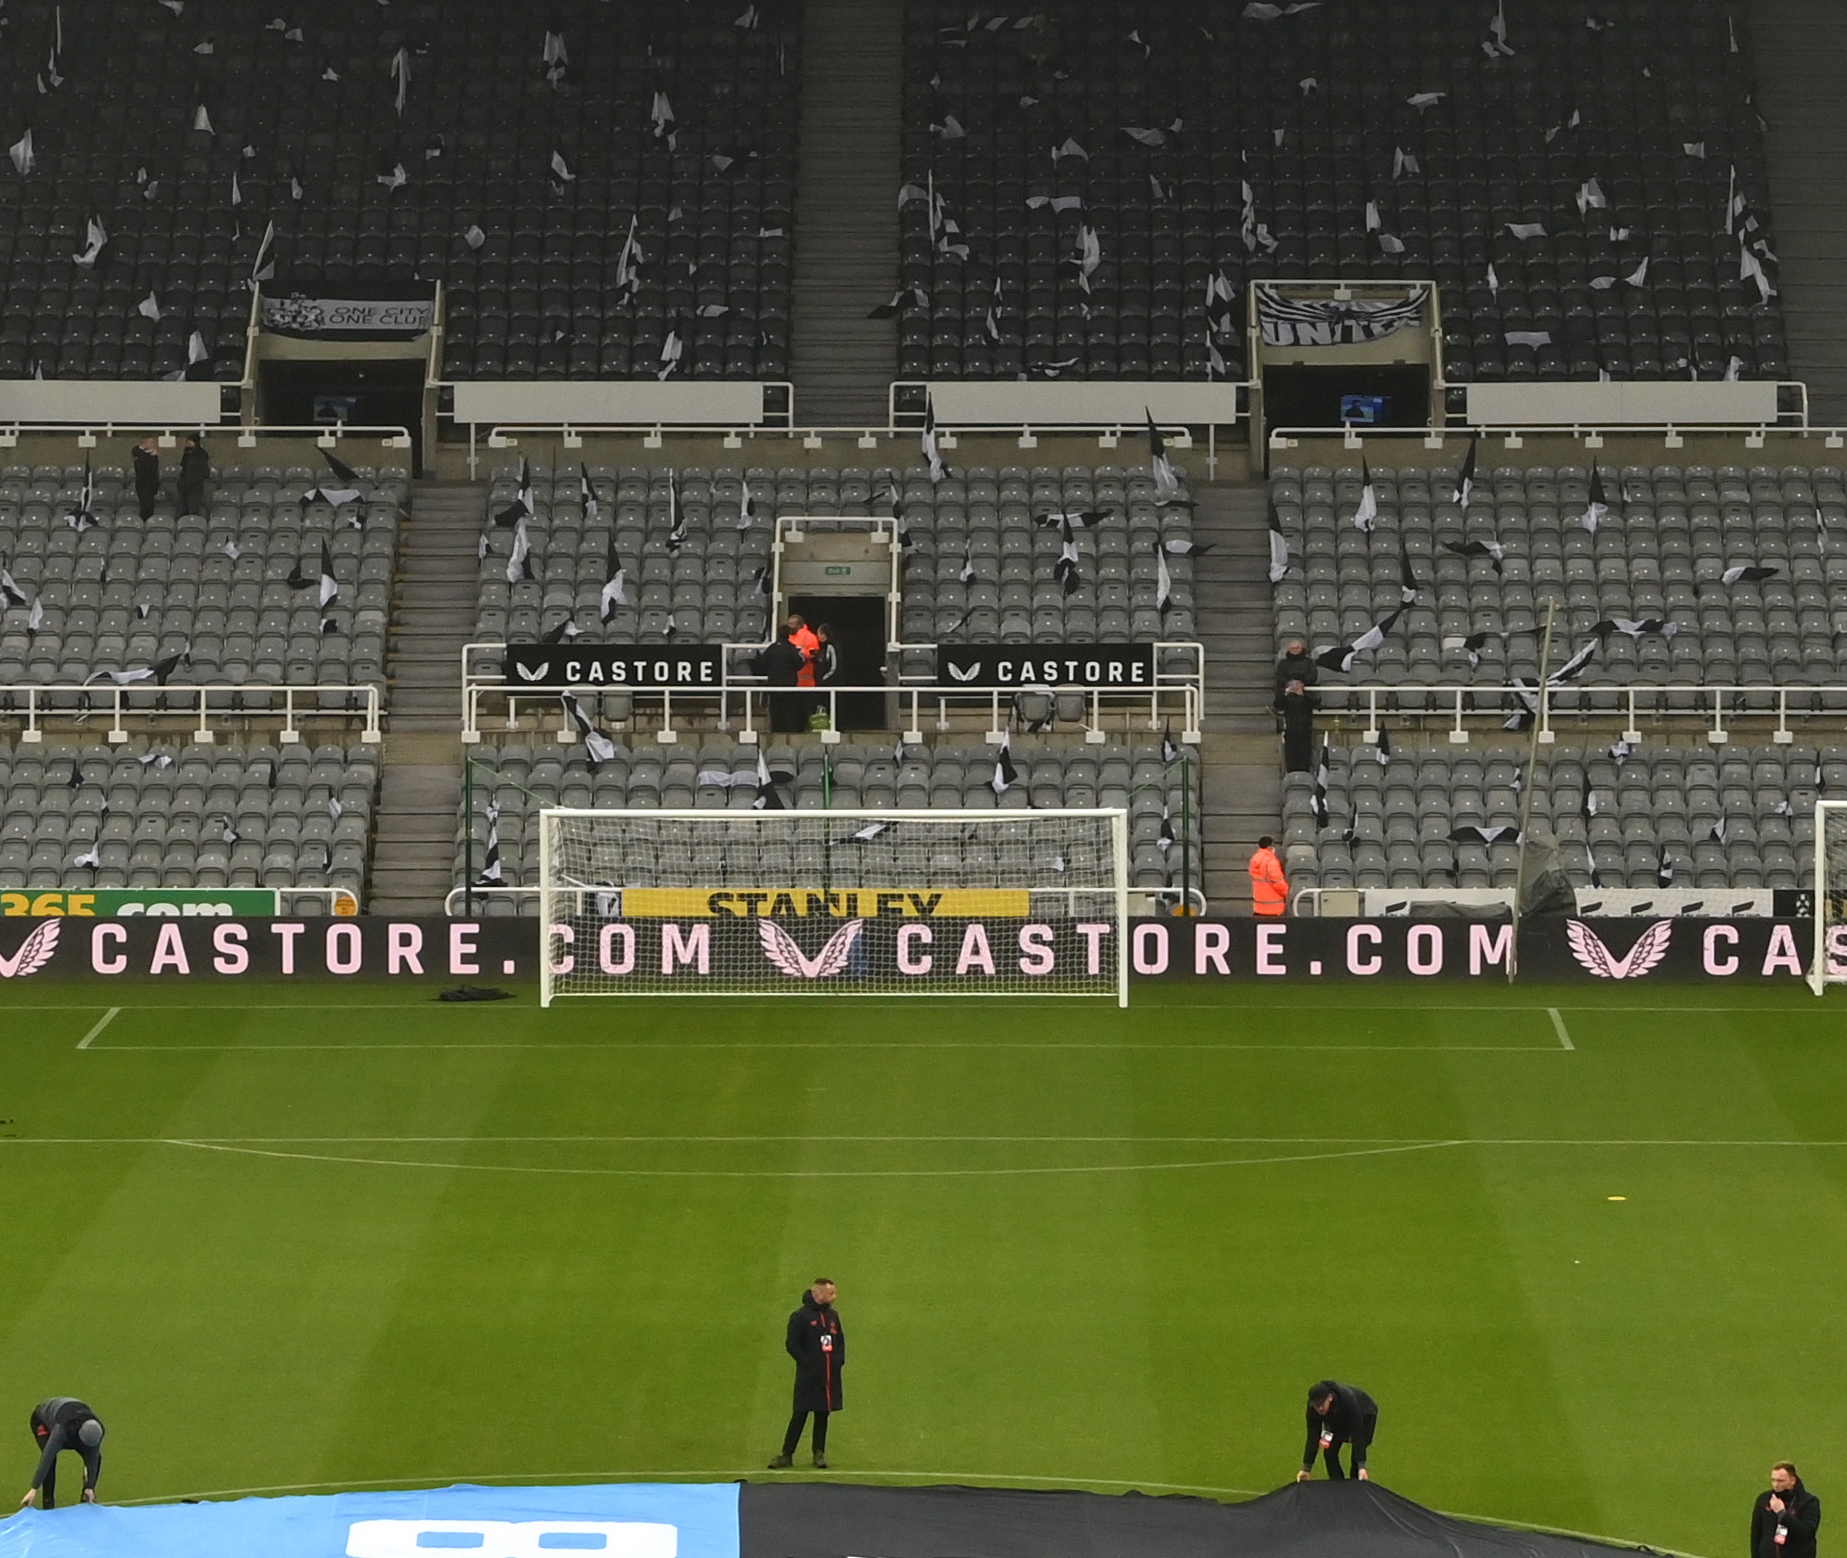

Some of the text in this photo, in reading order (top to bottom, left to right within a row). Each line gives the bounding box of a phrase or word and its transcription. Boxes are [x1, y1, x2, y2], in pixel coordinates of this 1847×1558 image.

[329, 315, 372, 324] ONE
[334, 307, 429, 315] ONE CITY
[565, 661, 715, 682] CASTORE
[996, 661, 1145, 682] CASTORE
[92, 923, 710, 974] CASTORE.COM
[897, 924, 1518, 975] CASTORE.COM
